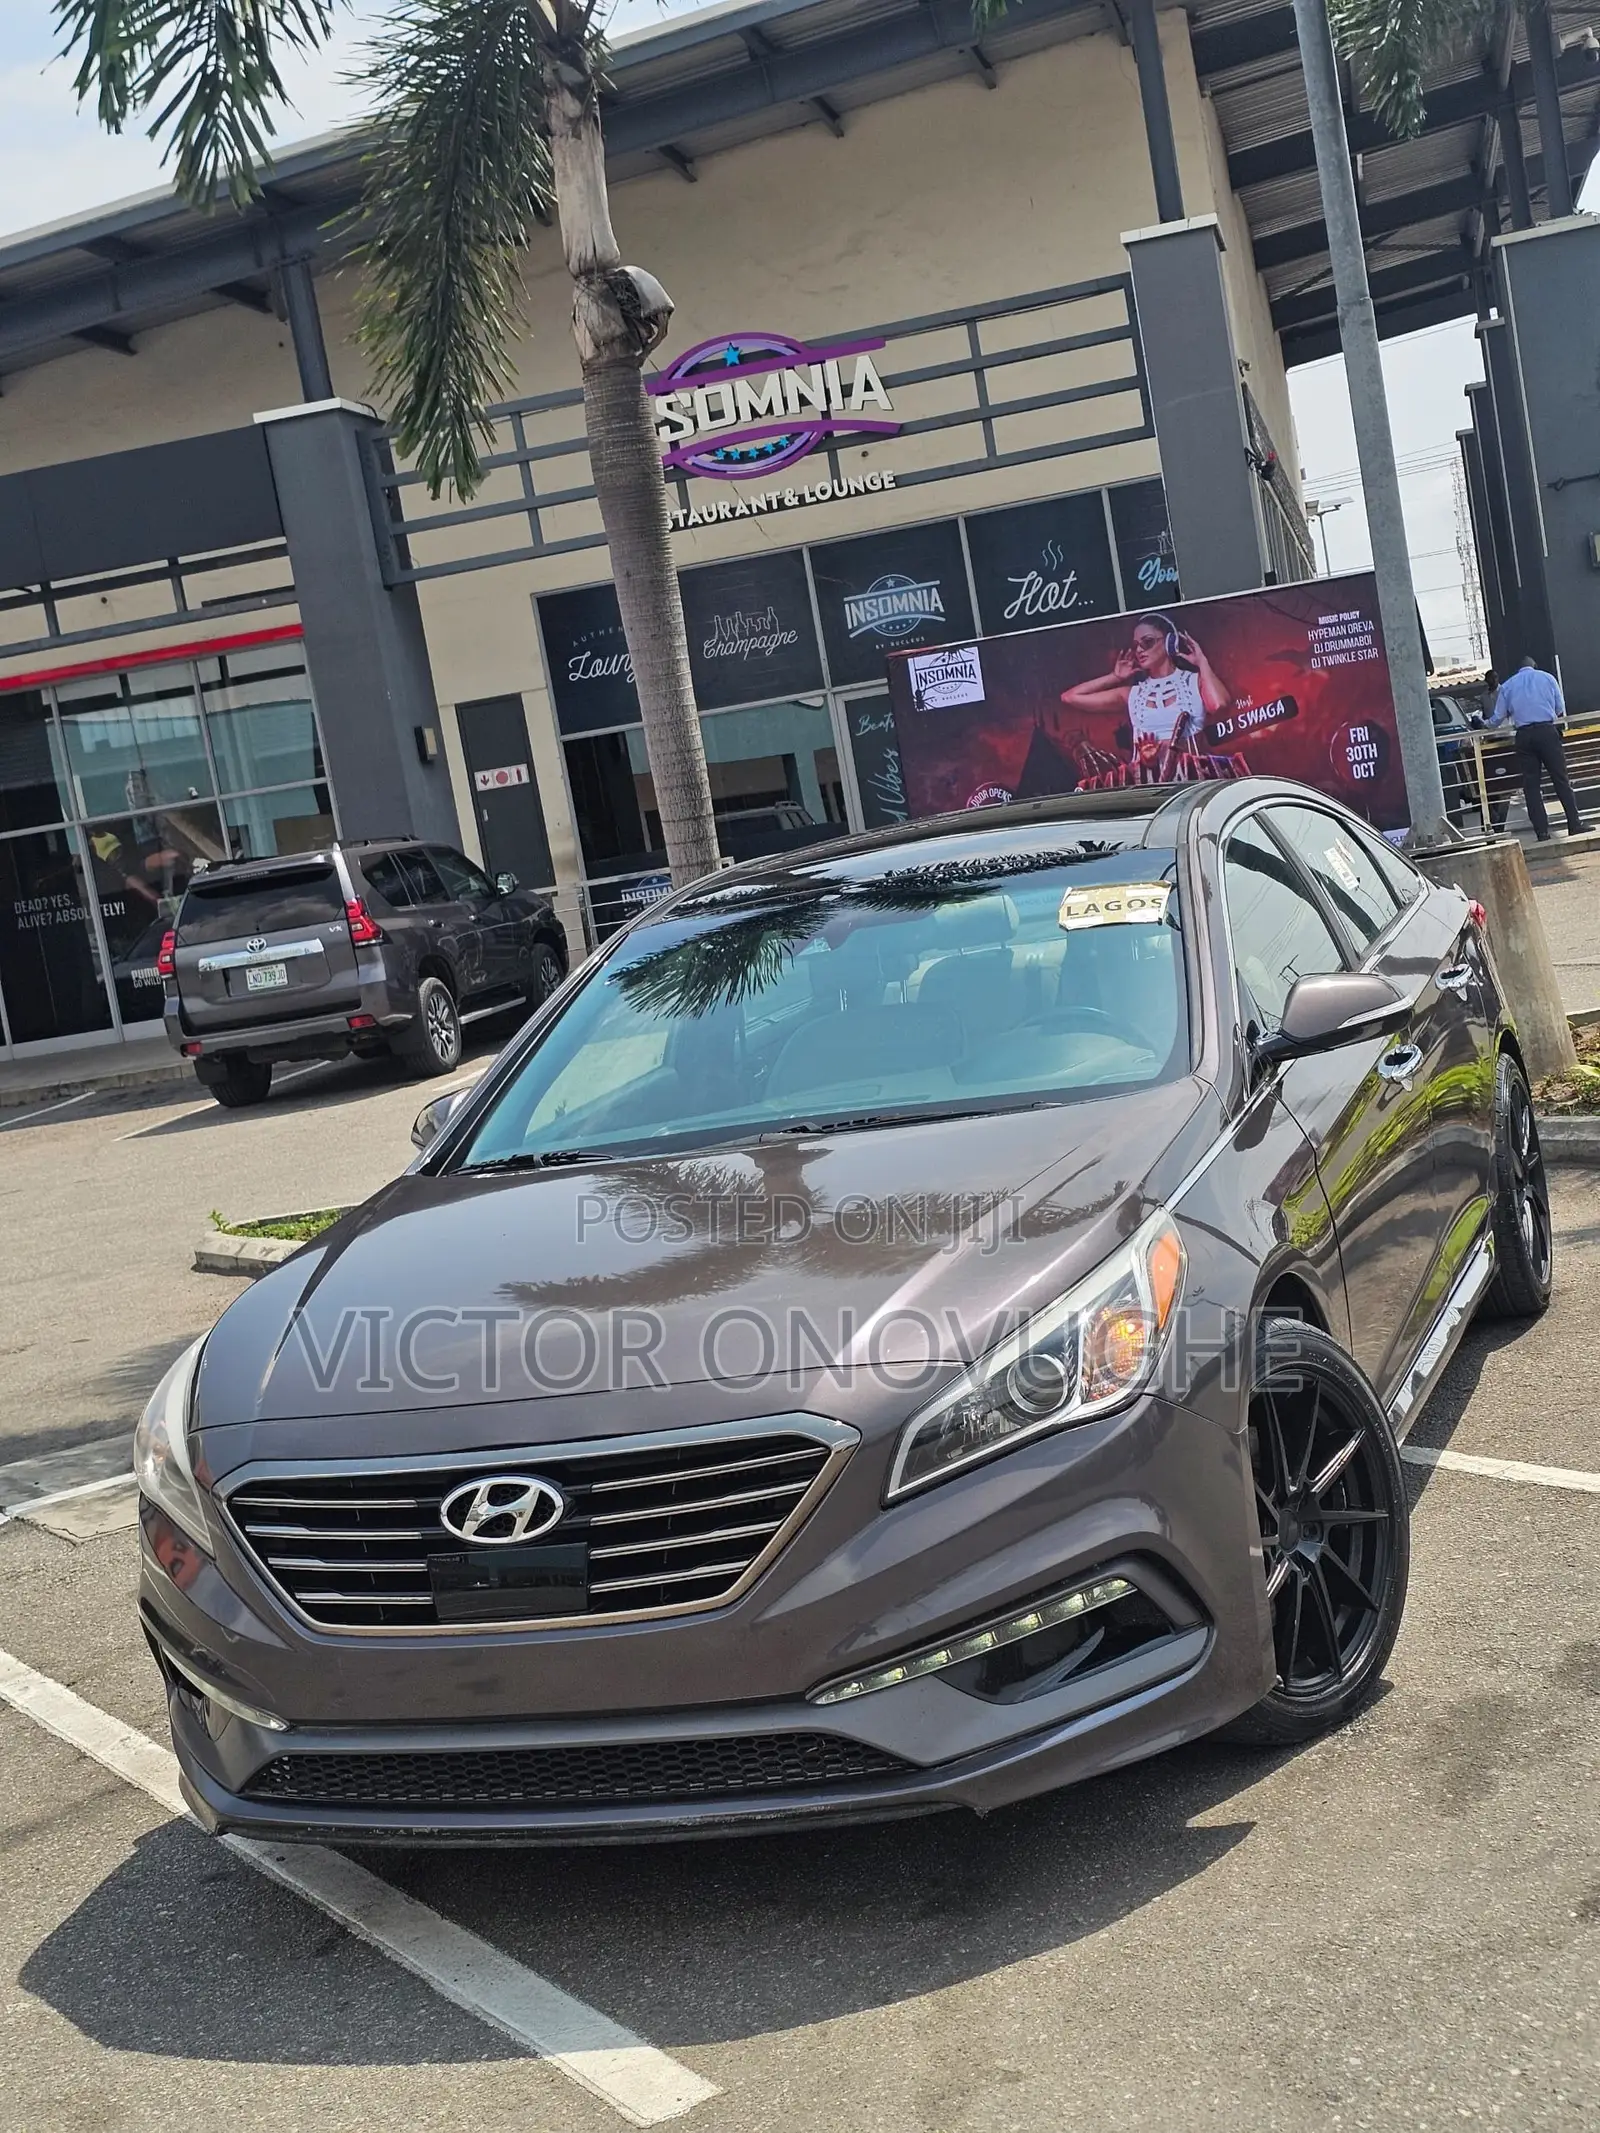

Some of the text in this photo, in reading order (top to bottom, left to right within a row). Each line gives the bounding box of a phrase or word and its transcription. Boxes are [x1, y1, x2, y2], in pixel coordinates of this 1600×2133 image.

[654, 355, 894, 442] SOMNIA
[667, 491, 783, 530] STAURANT
[804, 470, 896, 504] LOUNGE
[844, 587, 945, 630] INSOMNIA
[1318, 610, 1360, 625] MUSIC POLICY
[572, 626, 624, 647] AUTHEN
[1307, 620, 1375, 641] HYPEMAN OREVA
[703, 630, 798, 661] Champagne
[1314, 635, 1372, 654] DJ DRUMMABOI
[1311, 647, 1379, 669] DJ TWINKLE STAR
[915, 663, 977, 690] INSOMNIA
[1215, 699, 1285, 738] DJ SWAGA
[1349, 726, 1370, 743] FRI
[1345, 743, 1378, 762] 30TH
[1352, 761, 1376, 779] OCT
[970, 789, 990, 807] DOOR
[14, 893, 74, 914] DEAD? YES.
[621, 886, 674, 905] INSOM
[1066, 897, 1164, 917] LAGOS
[18, 912, 52, 930] ALIVE?
[133, 976, 162, 989] GO WILD
